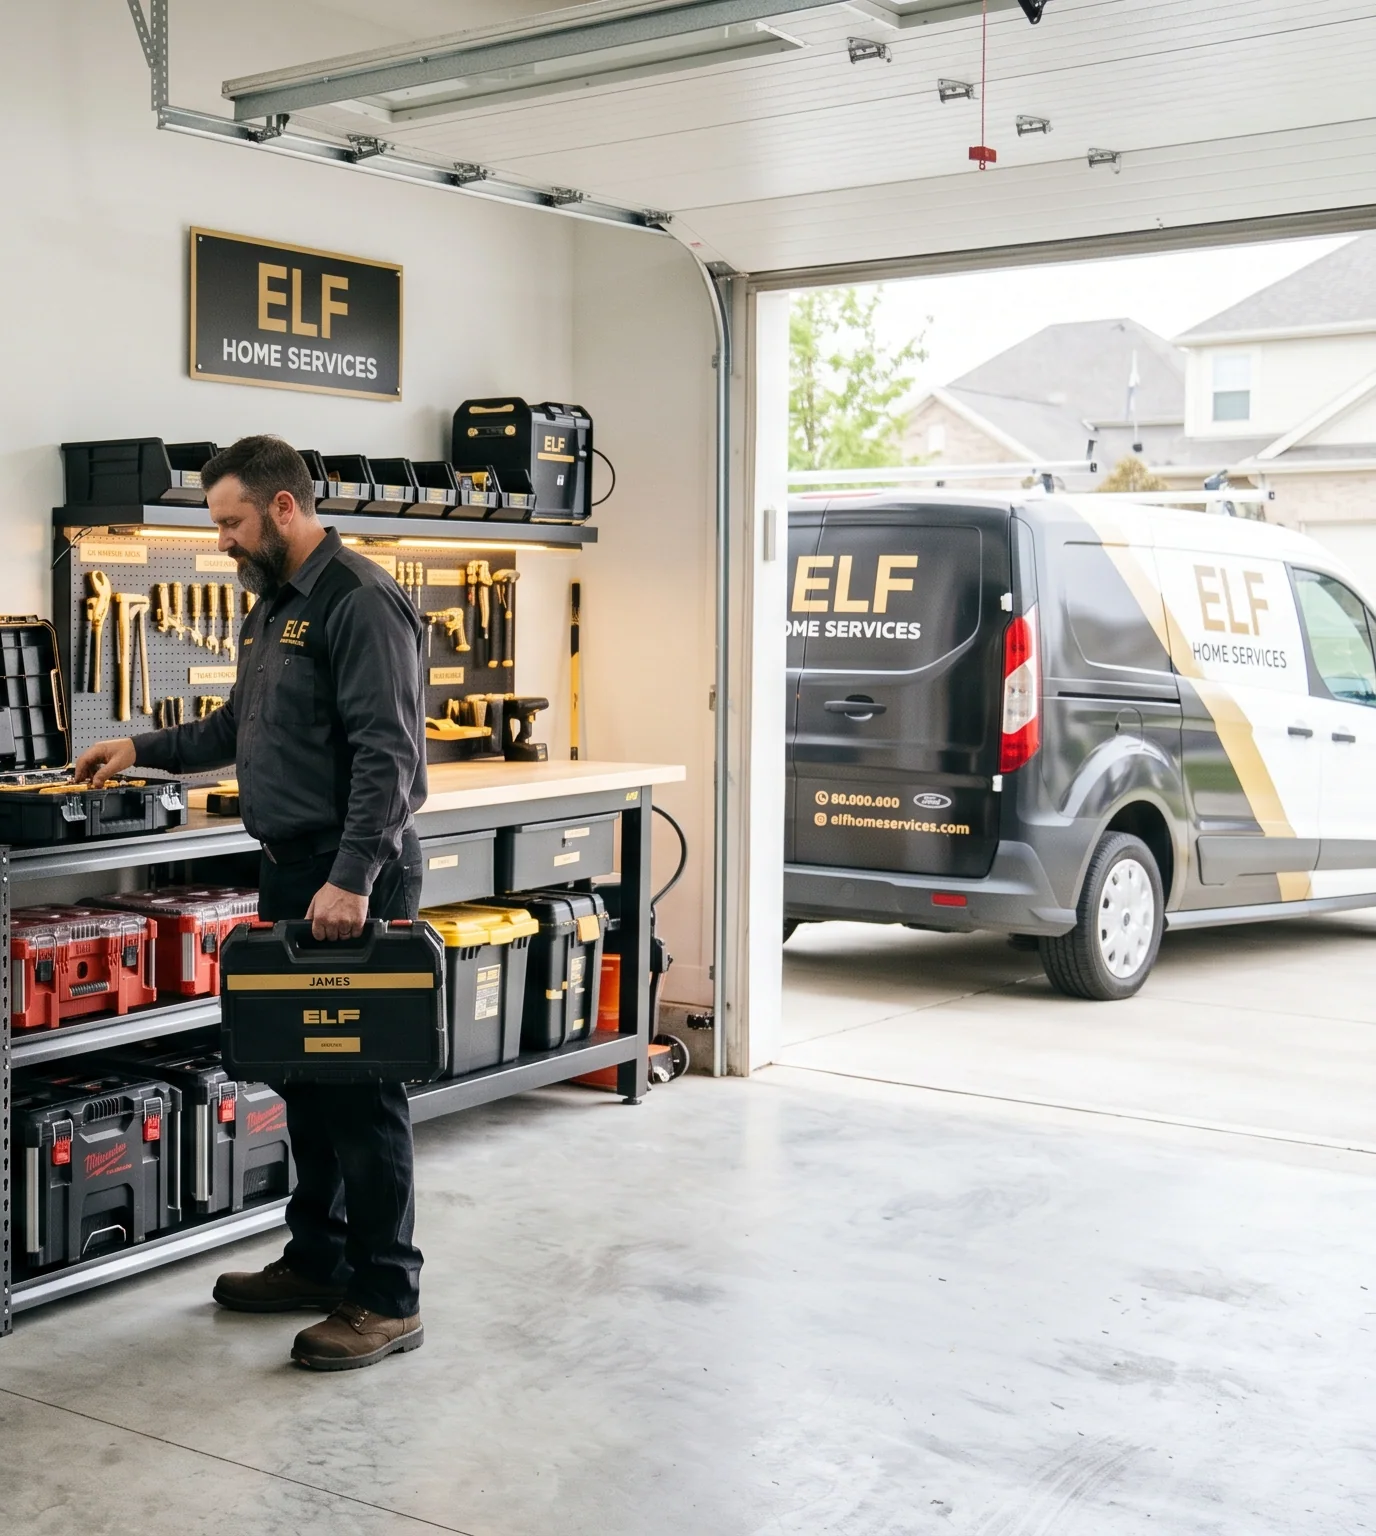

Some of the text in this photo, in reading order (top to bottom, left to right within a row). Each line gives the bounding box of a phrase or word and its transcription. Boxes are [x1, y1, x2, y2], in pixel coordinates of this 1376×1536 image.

[258, 262, 349, 339] ELF
[223, 338, 378, 380] HOME SERVICES
[544, 435, 566, 452] ELF
[791, 555, 919, 613] ELF
[1193, 564, 1269, 637] ELF
[282, 619, 310, 639] ELF
[786, 620, 922, 640] ME SERVICES
[1192, 642, 1287, 669] HOME SERVICES
[830, 813, 970, 835] elfhomeservices.com
[309, 976, 351, 987] JAMES
[303, 1009, 360, 1024] ELF
